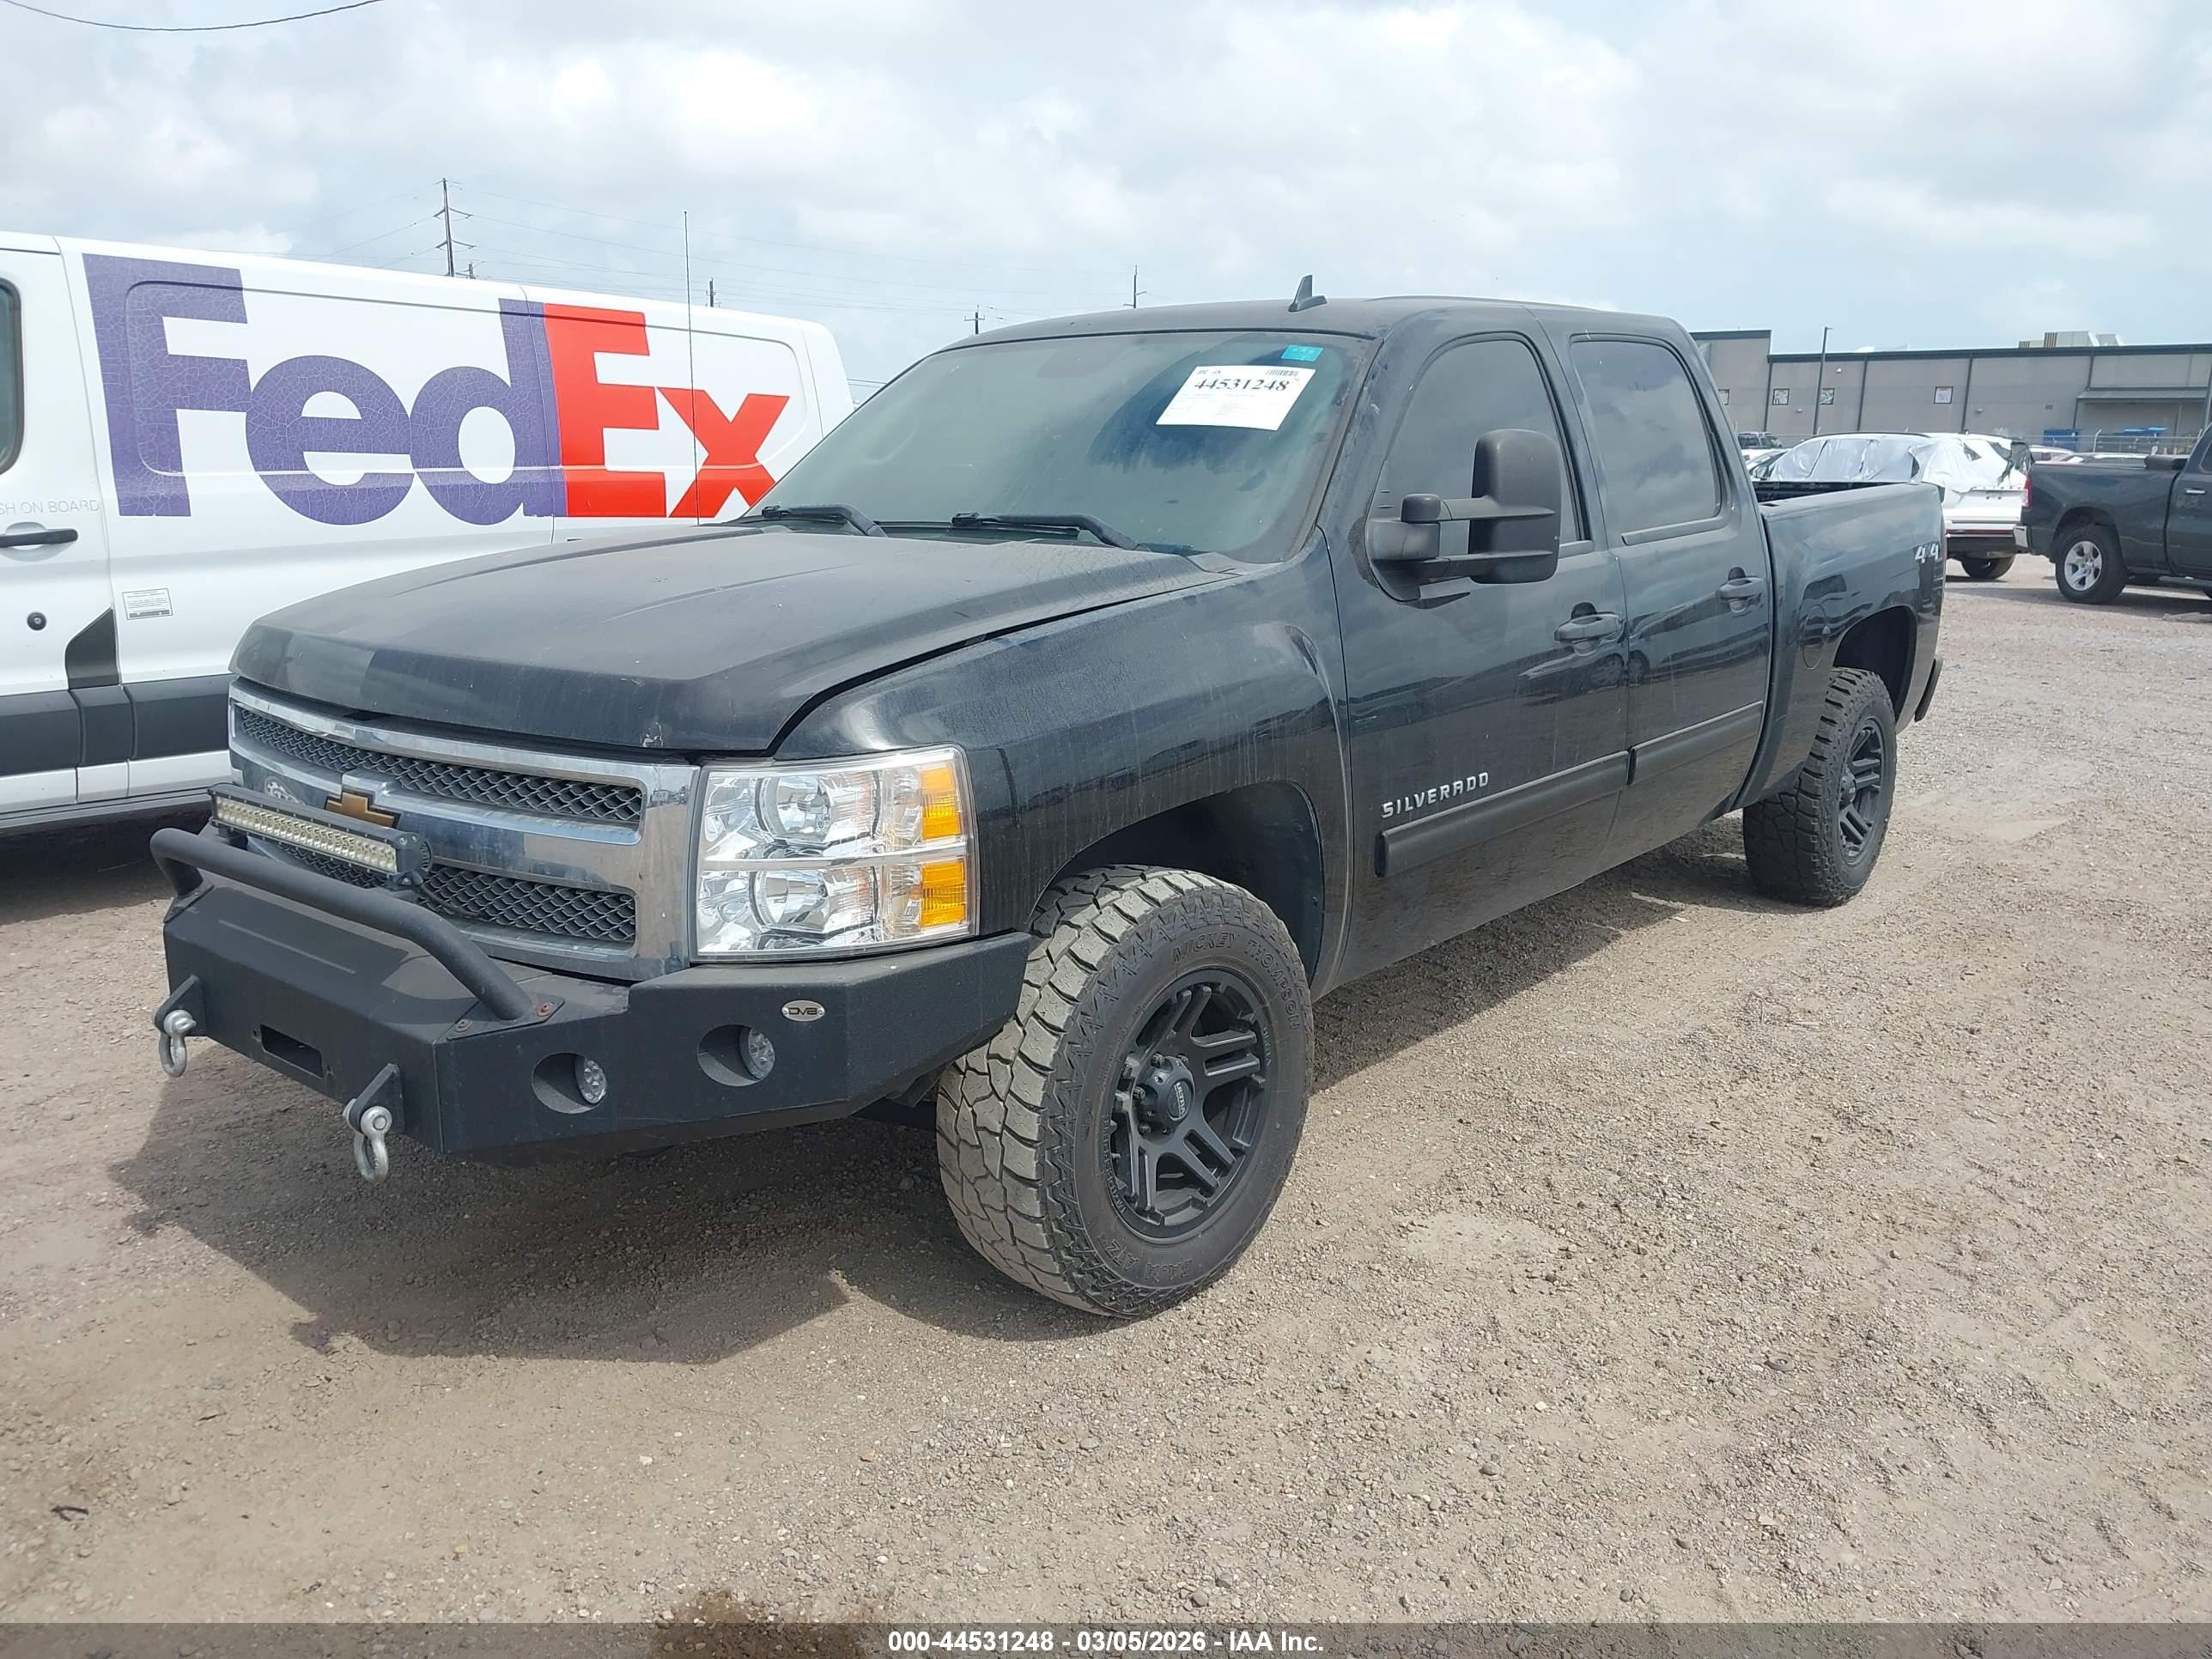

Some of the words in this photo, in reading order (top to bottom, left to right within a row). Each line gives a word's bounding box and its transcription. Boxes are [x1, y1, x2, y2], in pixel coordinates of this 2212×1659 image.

[82, 252, 790, 526] FedEx
[1194, 379, 1290, 392] 44531248
[21, 501, 44, 514] ON
[47, 500, 101, 514] BOARD
[1381, 771, 1489, 819] SILVERADO
[1172, 932, 1237, 963] MICKEY
[1243, 939, 1300, 1030] THOMPSON
[1175, 1082, 1186, 1115] ULTRA
